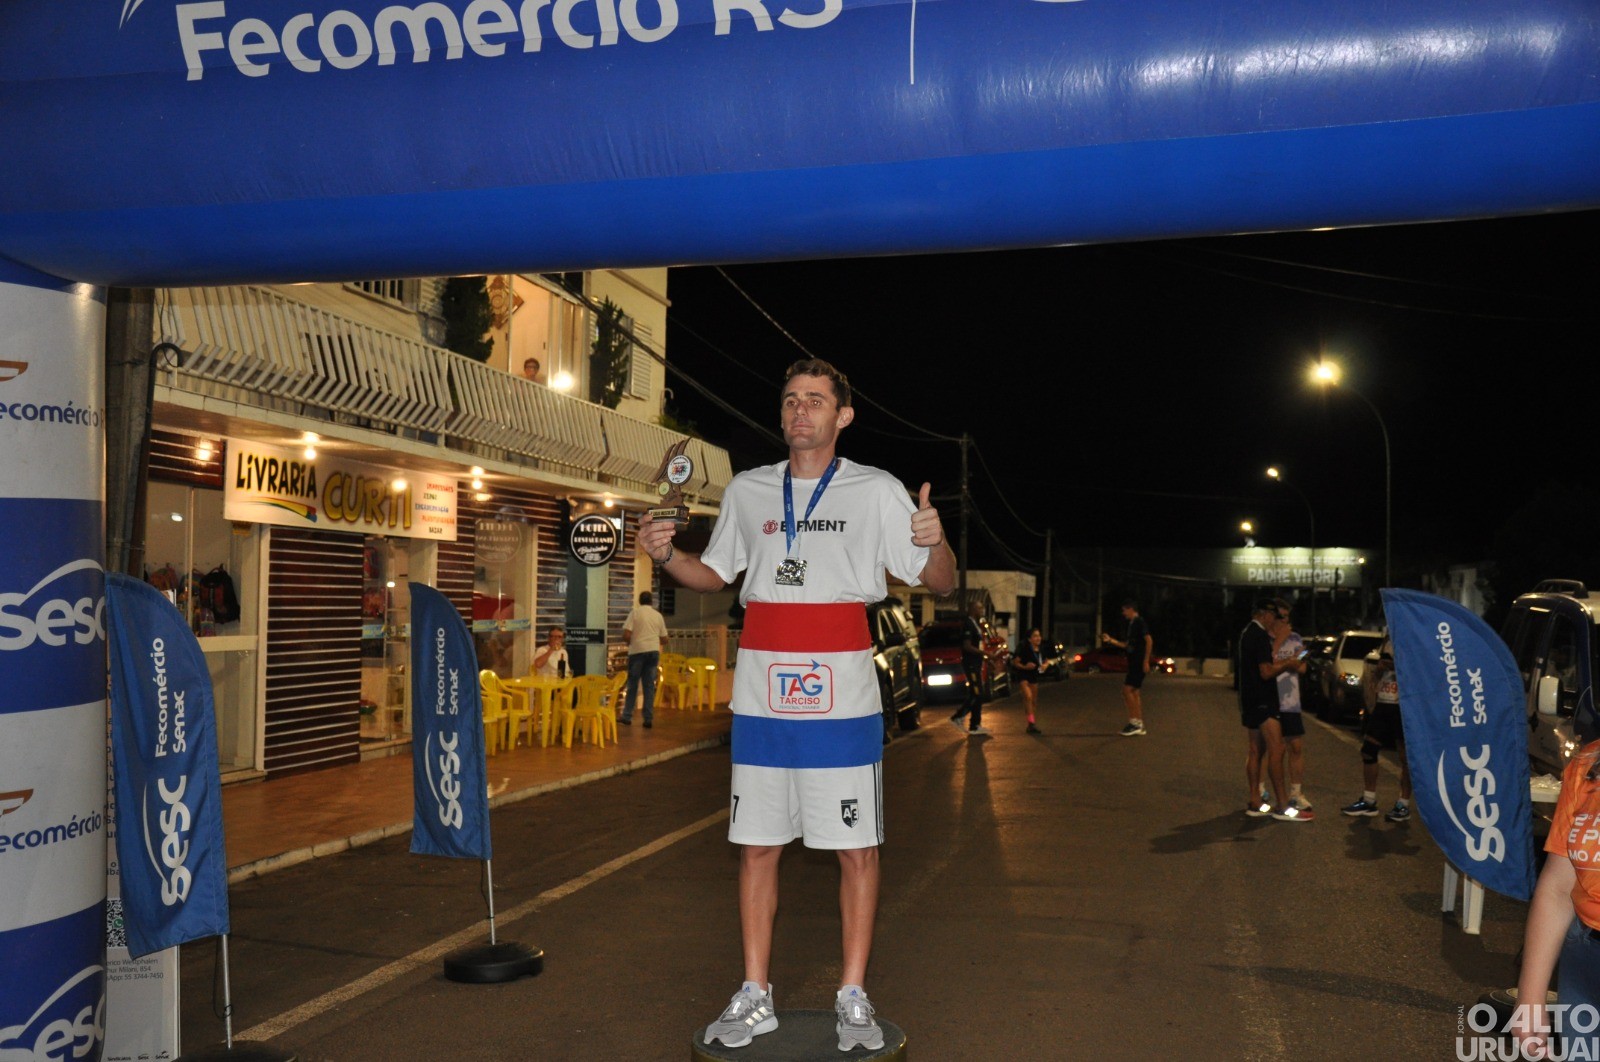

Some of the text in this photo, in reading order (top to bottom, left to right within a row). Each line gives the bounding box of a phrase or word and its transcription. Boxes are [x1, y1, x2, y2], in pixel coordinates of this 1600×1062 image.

[323, 471, 412, 529] CURTI
[580, 523, 609, 532] HOTEL
[780, 519, 846, 533] EEMENT
[1248, 568, 1290, 583] PADRE
[436, 627, 445, 715] Fecomércio
[1436, 622, 1466, 728] Fecomércio
[150, 637, 167, 757] Fecomércio
[777, 673, 823, 696] TAG
[780, 697, 820, 705] TARCISO
[733, 795, 740, 823] 7
